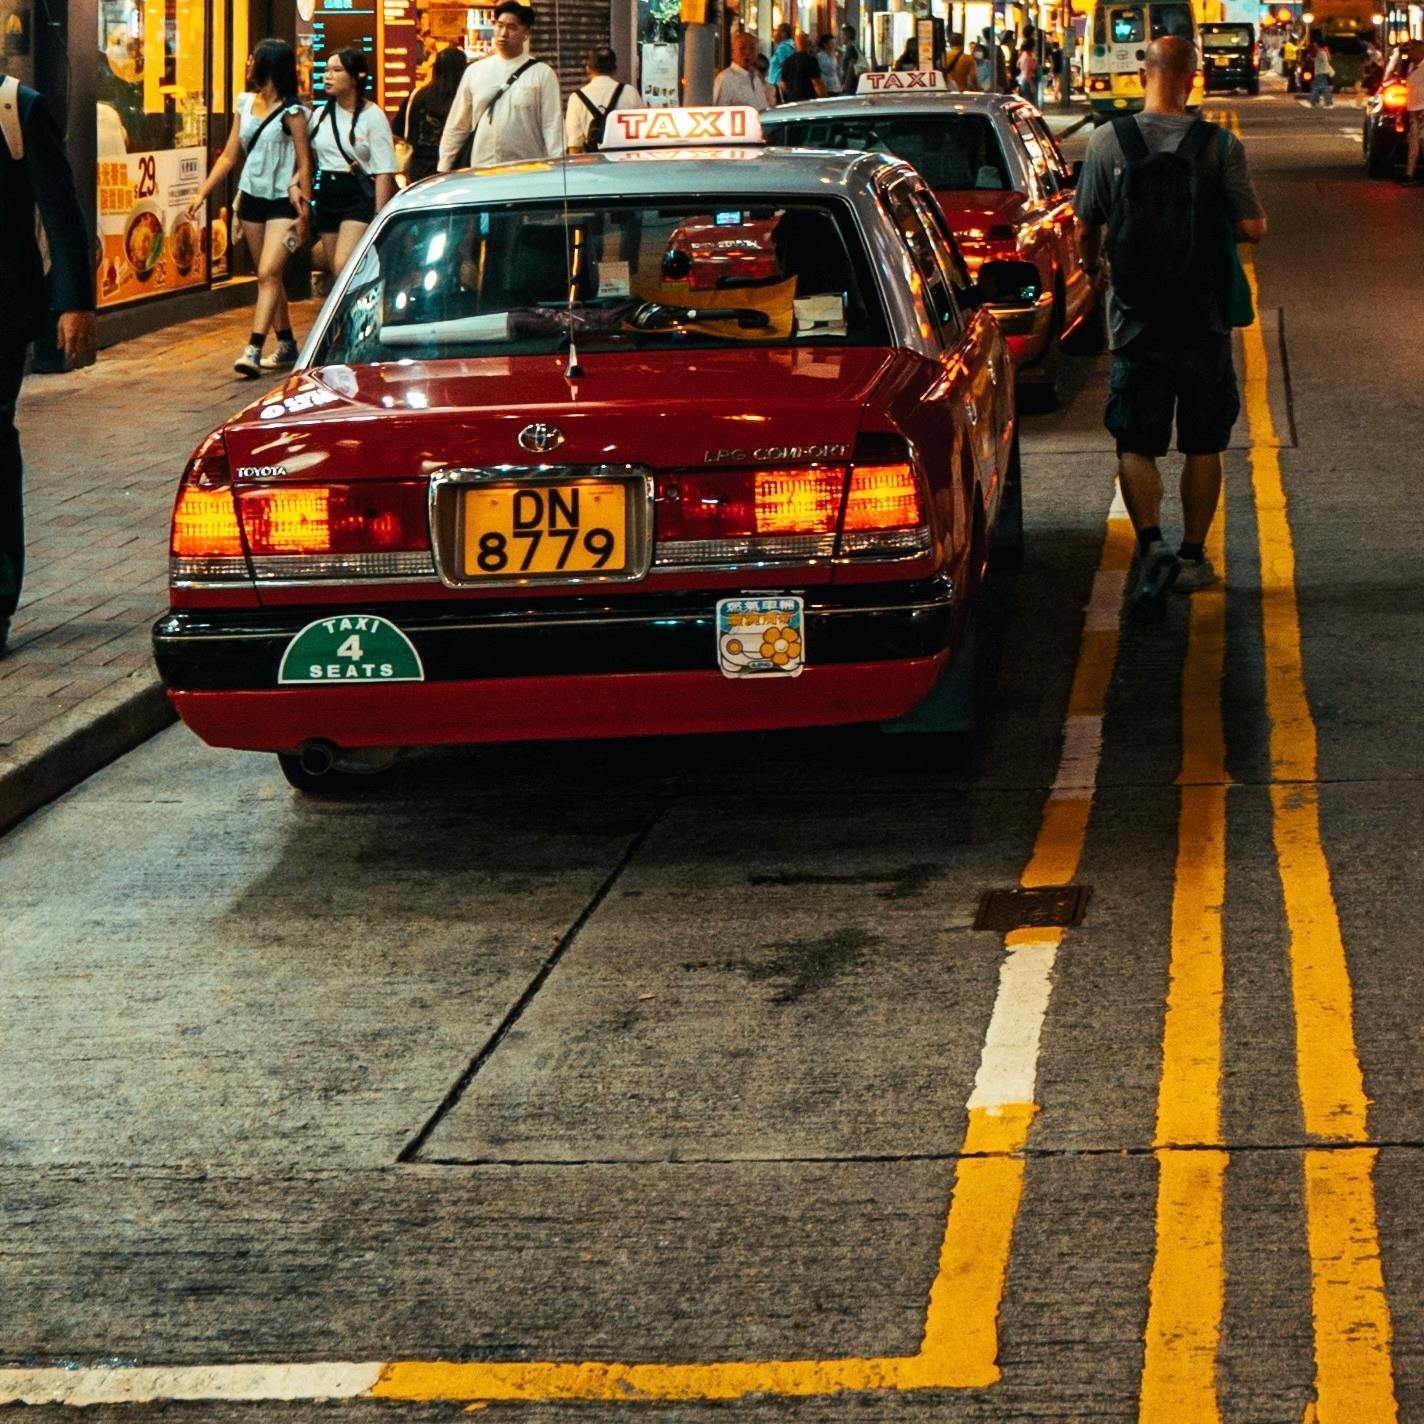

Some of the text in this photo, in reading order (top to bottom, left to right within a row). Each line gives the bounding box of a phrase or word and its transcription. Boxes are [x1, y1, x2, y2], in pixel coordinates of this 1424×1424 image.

[866, 72, 936, 90] TAXI
[617, 111, 746, 140] TAXI
[236, 466, 287, 478] TOYOTA
[512, 487, 580, 530] DN
[476, 527, 615, 572] 8779
[322, 617, 380, 634] TAXI
[336, 634, 363, 661] 4
[309, 663, 394, 678] SEATS
